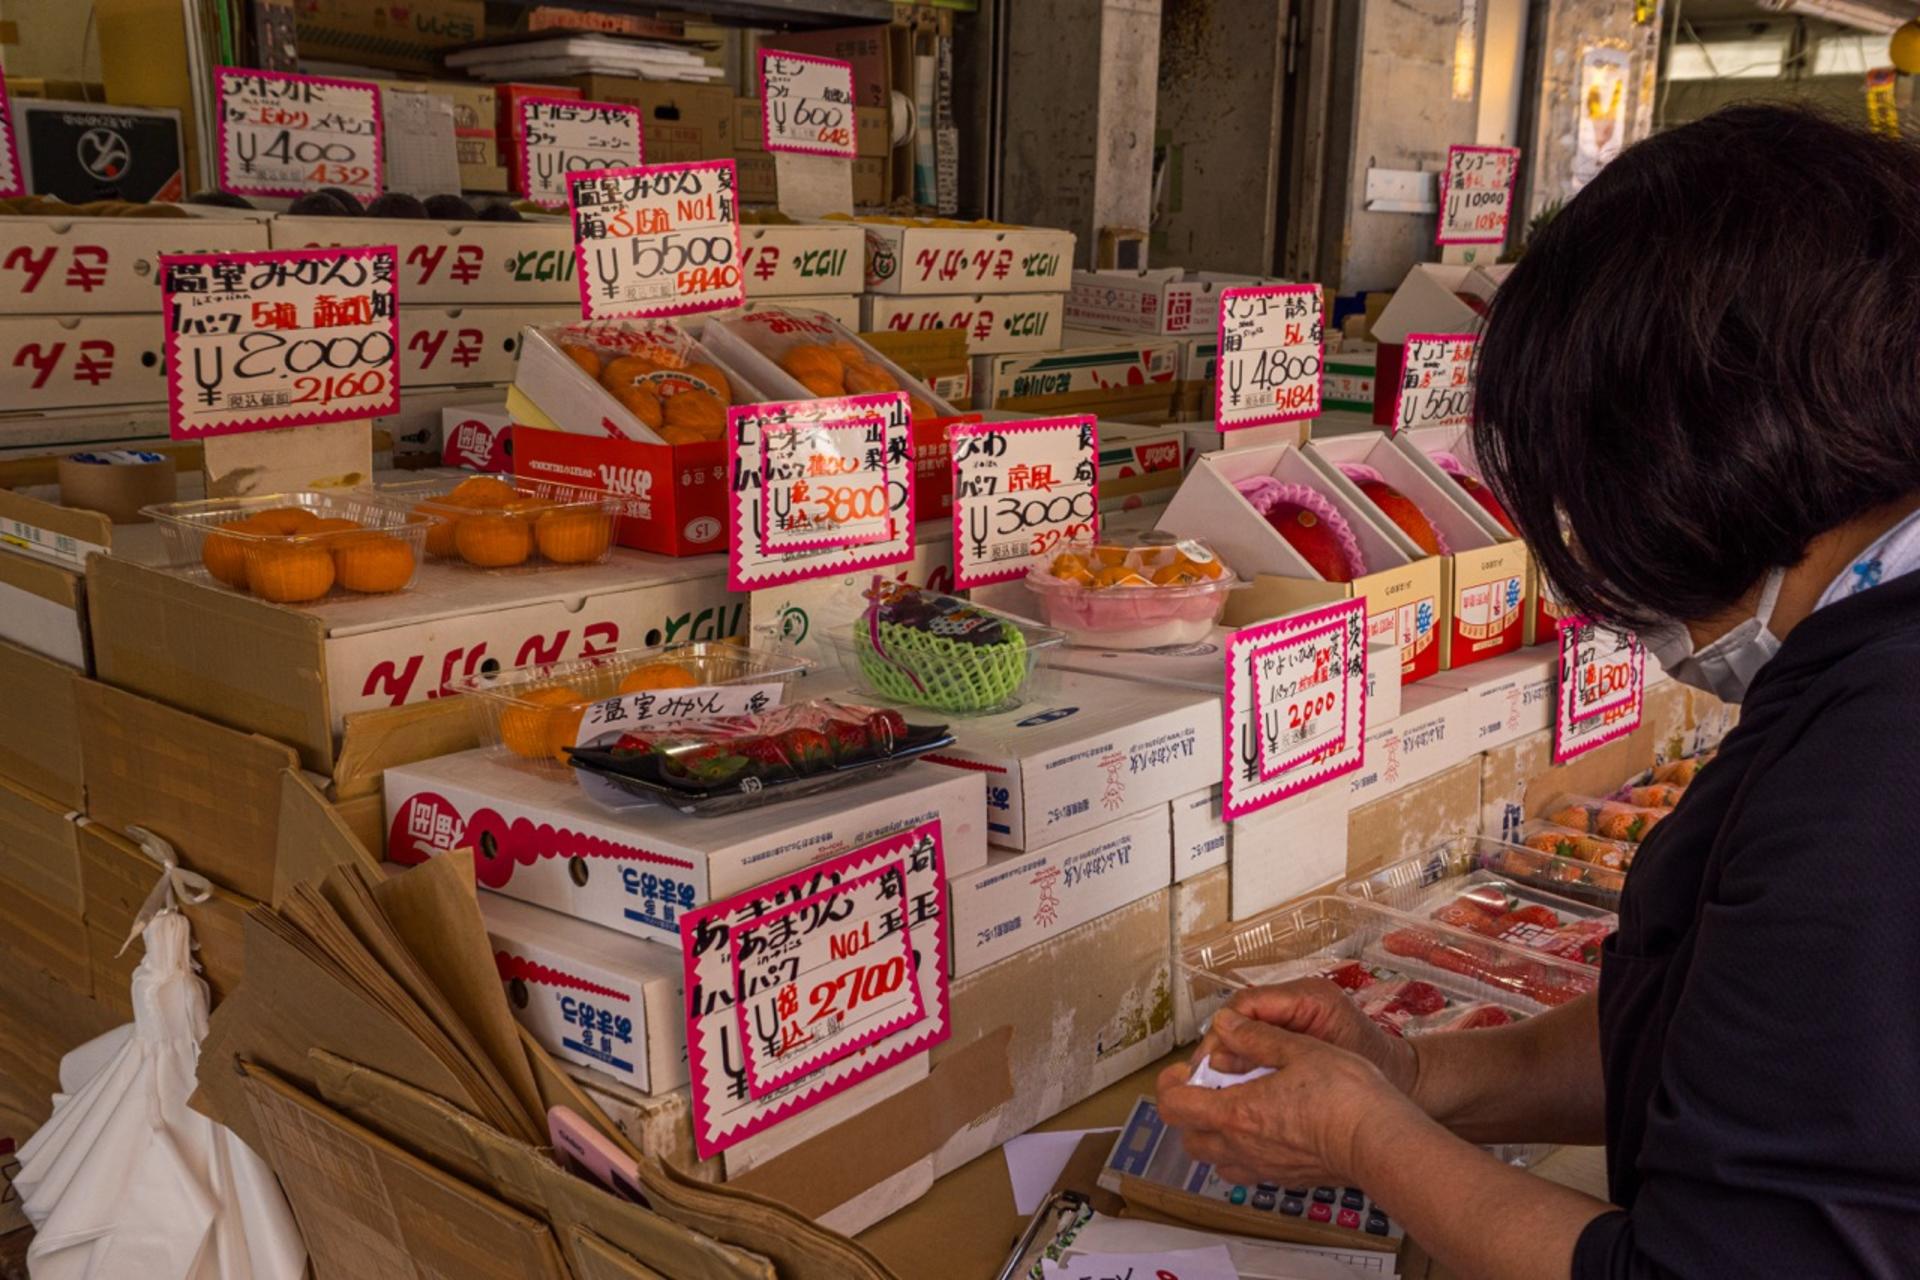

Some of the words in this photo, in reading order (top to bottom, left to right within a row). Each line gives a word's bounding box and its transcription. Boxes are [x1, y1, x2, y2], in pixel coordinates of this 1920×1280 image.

[818, 127, 850, 146] 648
[305, 163, 370, 184] 432
[1454, 153, 1495, 170] マンゴー
[573, 169, 703, 208] 温室みかん
[166, 254, 369, 293] 温室みかん
[797, 248, 848, 278] ハウス
[1024, 251, 1060, 279] ハウス
[1224, 296, 1281, 319] マンゴー
[1009, 311, 1049, 337] ハウス
[1409, 340, 1453, 362] マンゴー
[290, 370, 385, 405] 2160
[1275, 383, 1314, 410] 5184
[956, 431, 1007, 462] びわ
[598, 464, 656, 500] みかん
[695, 524, 712, 545] 15
[591, 692, 725, 725] 温室みかん
[409, 800, 468, 852] 福岡
[621, 867, 696, 912] あまおう
[738, 894, 855, 962] あまりん
[739, 957, 800, 1001] 1パック
[560, 995, 633, 1044] あまおう
